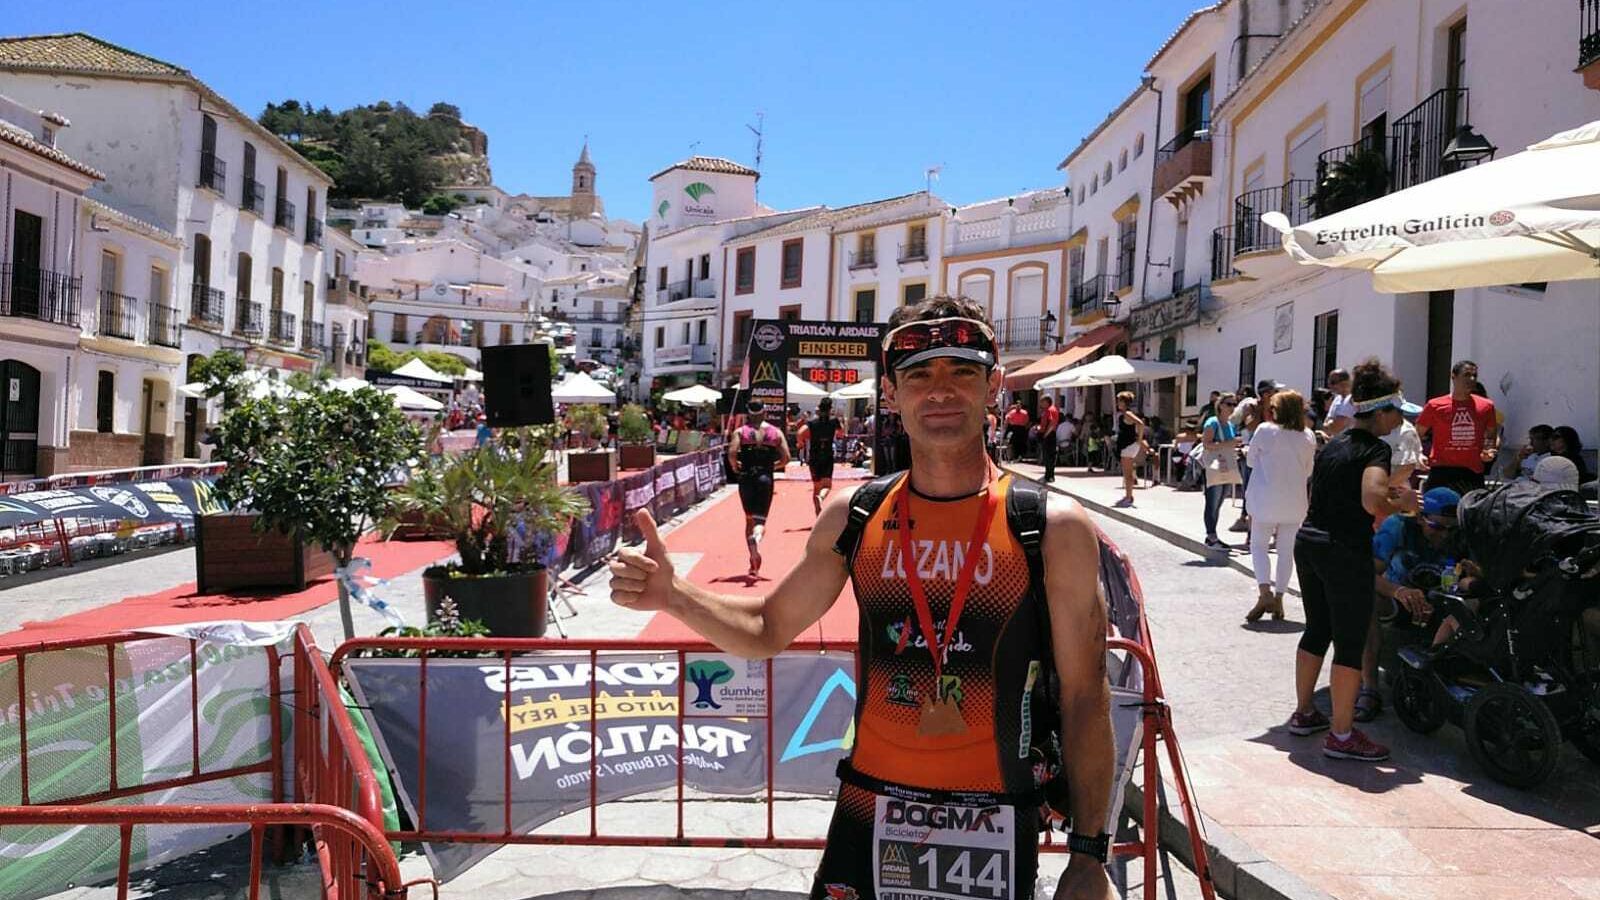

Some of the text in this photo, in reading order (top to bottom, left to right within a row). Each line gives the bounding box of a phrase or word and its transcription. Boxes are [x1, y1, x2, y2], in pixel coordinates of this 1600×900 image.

[1315, 213, 1485, 246] Estrella Galicia
[788, 324, 880, 338] TRIATLÓN ARDALES
[801, 343, 865, 355] FINISHER
[881, 540, 992, 586] LOZANO
[720, 686, 765, 696] dumher
[918, 848, 1007, 898] 144
